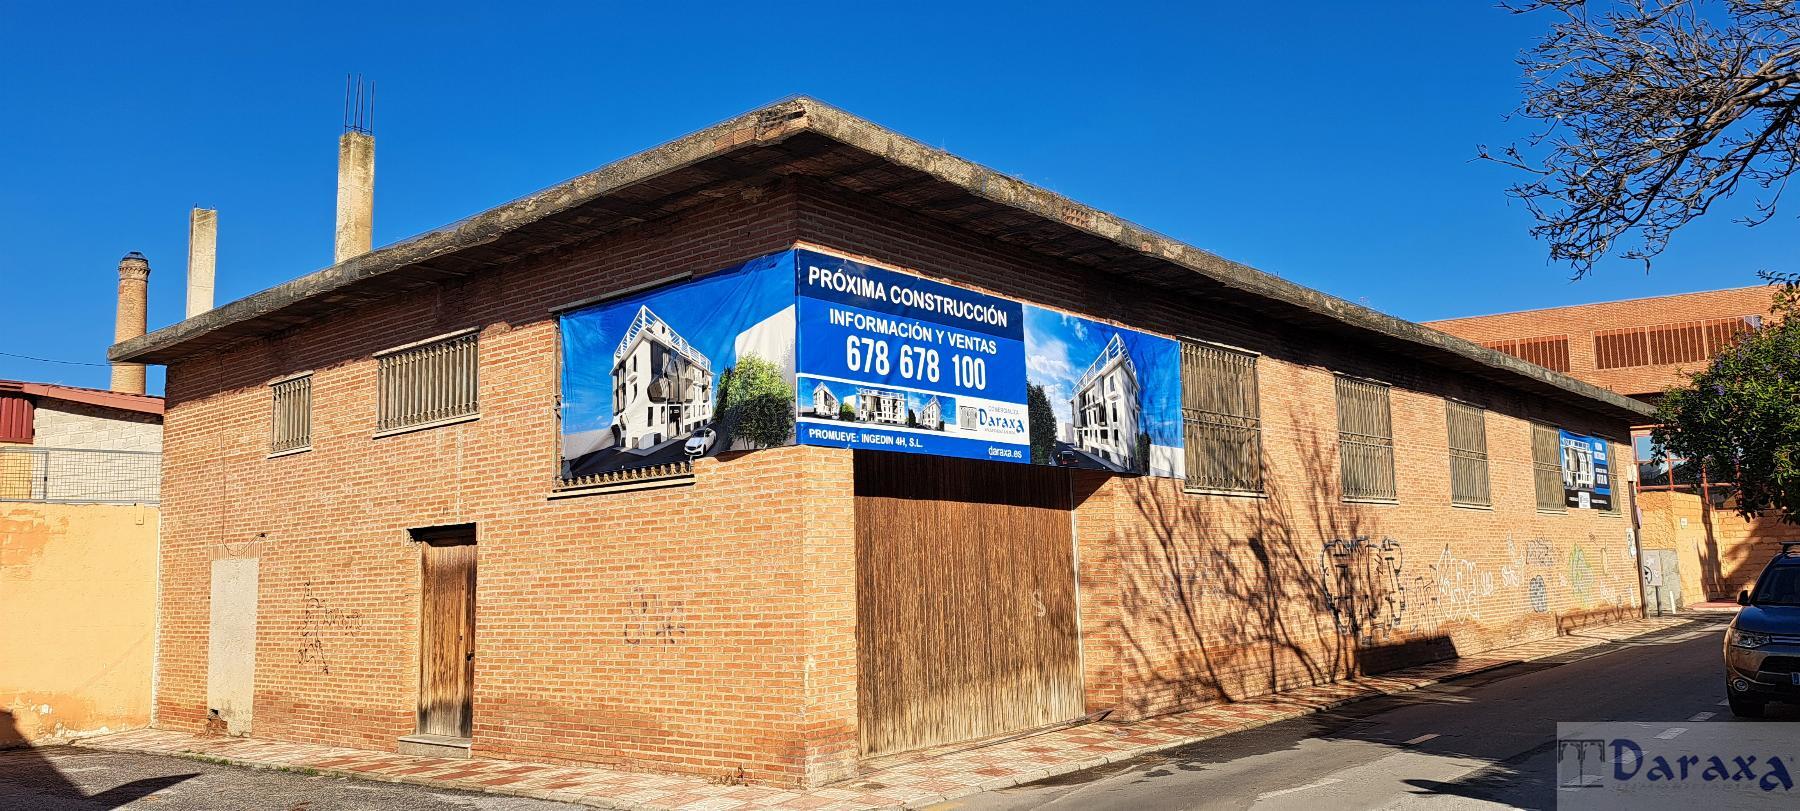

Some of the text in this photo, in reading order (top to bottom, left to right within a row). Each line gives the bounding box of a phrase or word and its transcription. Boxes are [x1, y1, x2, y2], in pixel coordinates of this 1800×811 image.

[808, 266, 1008, 327] PRÓXIMA CONSTRUCCIÓN
[829, 308, 997, 355] INFORMACIÓN Y VENTAS
[846, 335, 986, 391] 678 678 100
[808, 428, 860, 443] PROMUEVE:
[861, 433, 894, 446] INGEDIN
[908, 437, 924, 448] S.L.
[988, 445, 1023, 459] daraxa.es
